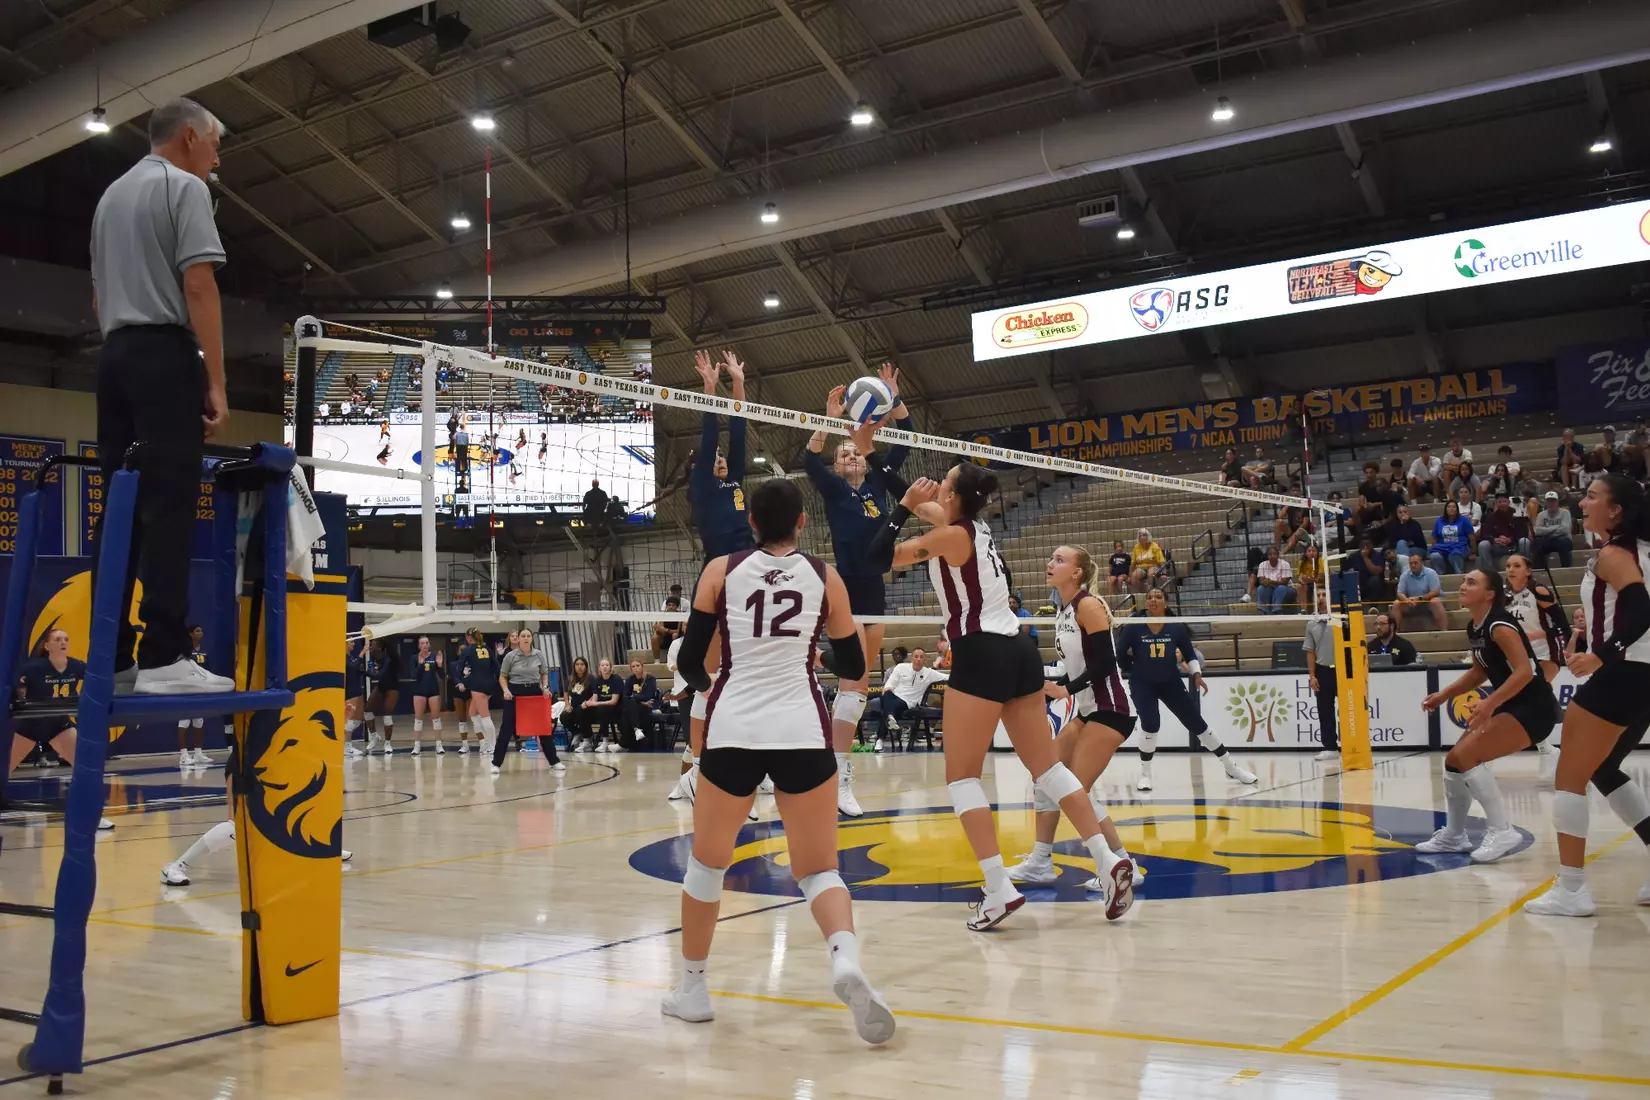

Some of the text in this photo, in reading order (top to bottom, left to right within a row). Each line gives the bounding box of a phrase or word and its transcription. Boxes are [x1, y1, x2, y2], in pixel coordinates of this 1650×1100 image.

[1472, 240, 1583, 274] Greenville
[1290, 264, 1335, 277] NORTHEAST
[1291, 273, 1334, 291] TEXAS
[1177, 284, 1229, 313] ASG
[1005, 310, 1075, 331] Chicken
[1040, 324, 1077, 337] EXPRESS
[504, 360, 572, 380] EAST TEXAS A&M
[1588, 350, 1634, 384] Fix
[594, 377, 655, 396] EAST TEXAS A&M
[1601, 376, 1650, 409] Fee
[674, 392, 729, 409] EAST TEXAS A&M
[1028, 369, 1517, 449] LION MEN'S BASKETBALL
[746, 405, 795, 420] EAST TEXAS A&M
[1079, 436, 1173, 460] CHAMPIONSHIPS
[1201, 430, 1236, 448] NCAA
[1391, 399, 1507, 427] ALL-AMERICANS
[12, 443, 46, 453] MEN'S
[745, 589, 803, 638] 12
[1149, 643, 1165, 658] 17
[52, 684, 70, 698] 14
